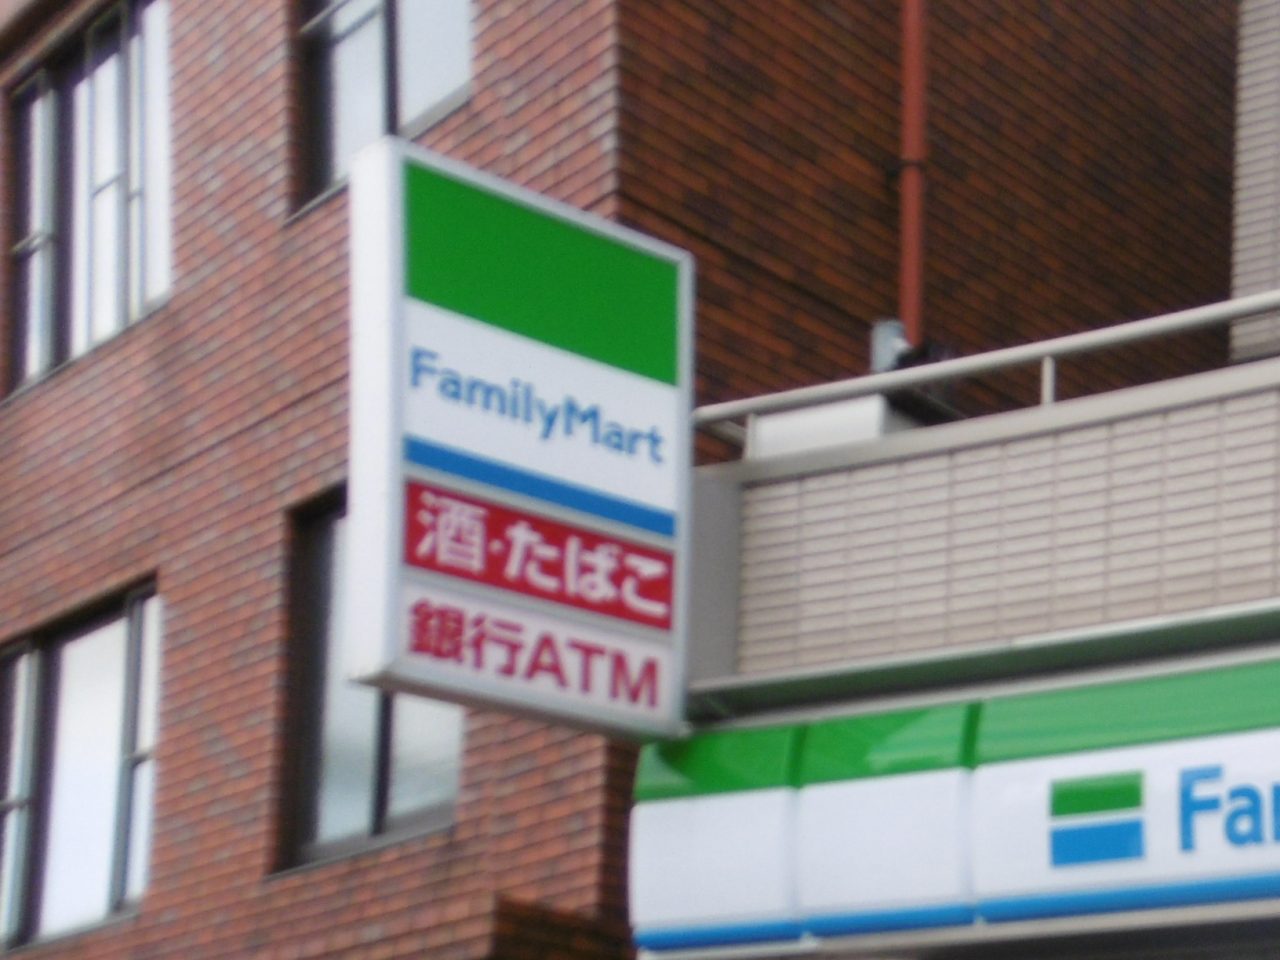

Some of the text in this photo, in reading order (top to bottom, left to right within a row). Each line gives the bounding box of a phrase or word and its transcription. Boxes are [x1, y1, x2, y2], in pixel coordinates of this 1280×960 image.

[409, 344, 664, 463] FamilyMart
[415, 490, 669, 618] 酒・たばこ
[409, 599, 660, 707] 銀行ATM
